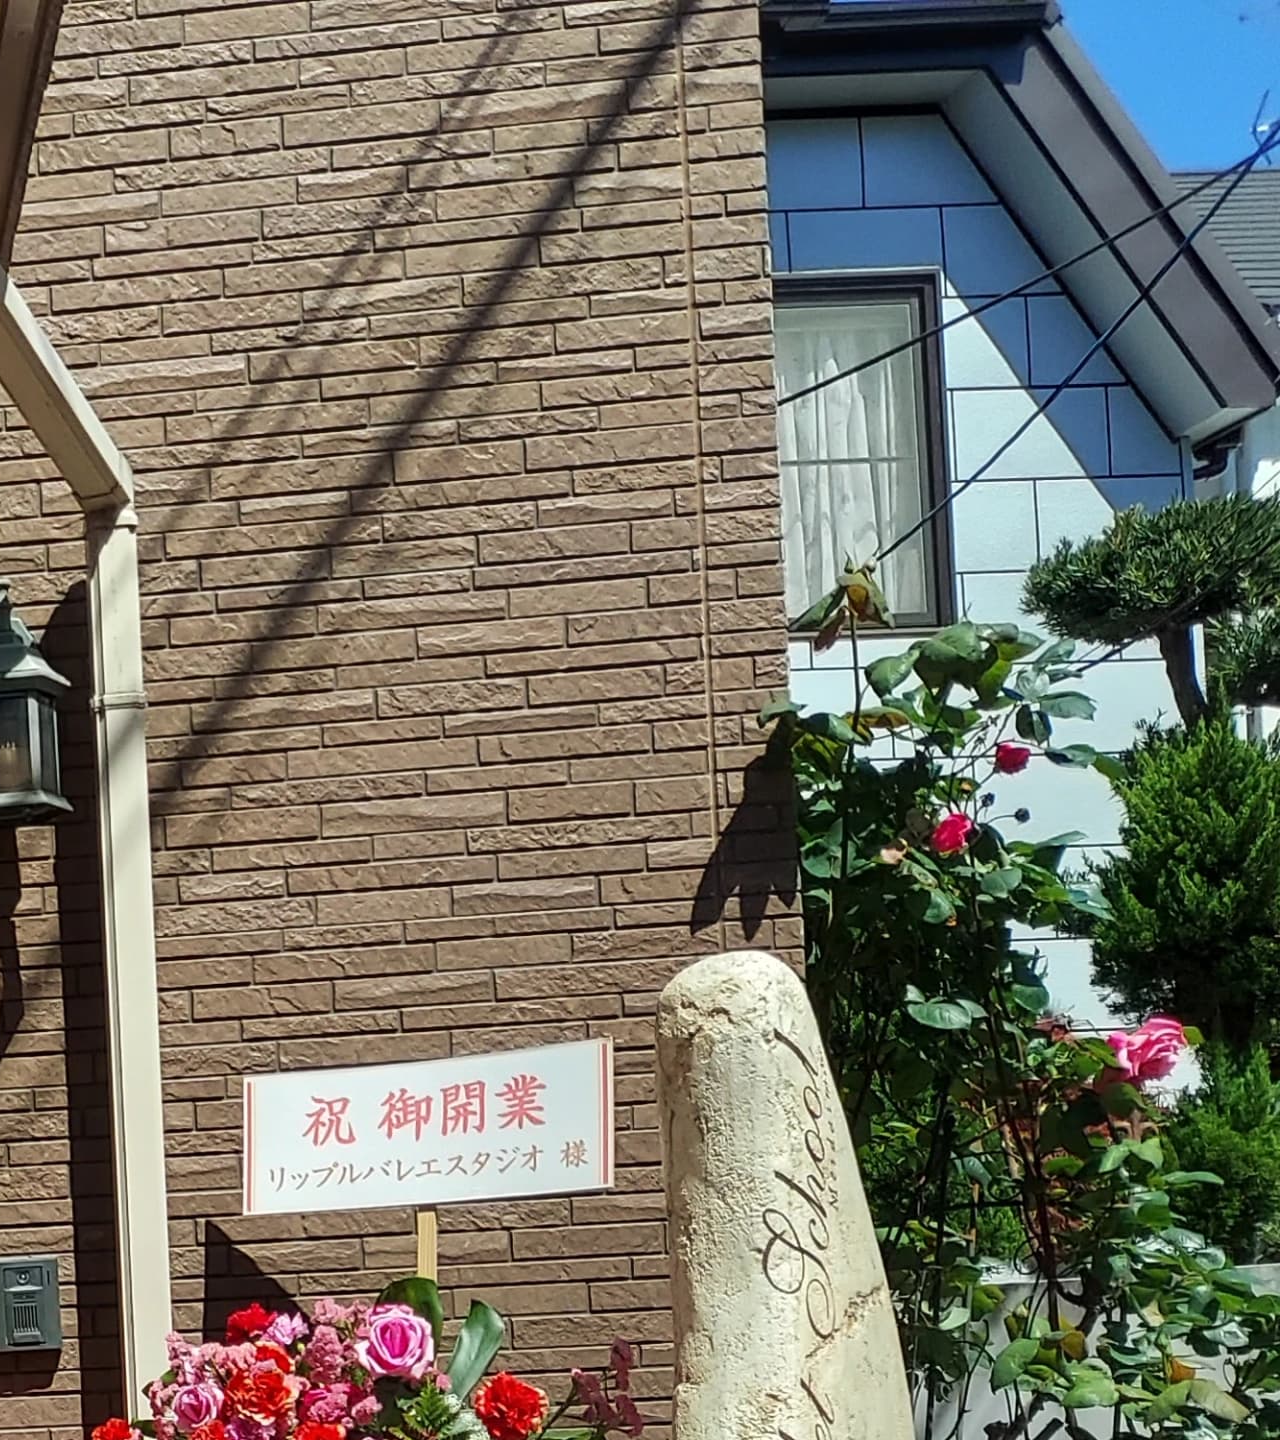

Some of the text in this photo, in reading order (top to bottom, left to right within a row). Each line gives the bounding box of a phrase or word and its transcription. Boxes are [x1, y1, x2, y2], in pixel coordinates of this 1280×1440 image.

[302, 1073, 547, 1147] 祝 御開業
[268, 1138, 590, 1192] リップルバレエスタジオ 様
[761, 1027, 836, 1339] School
